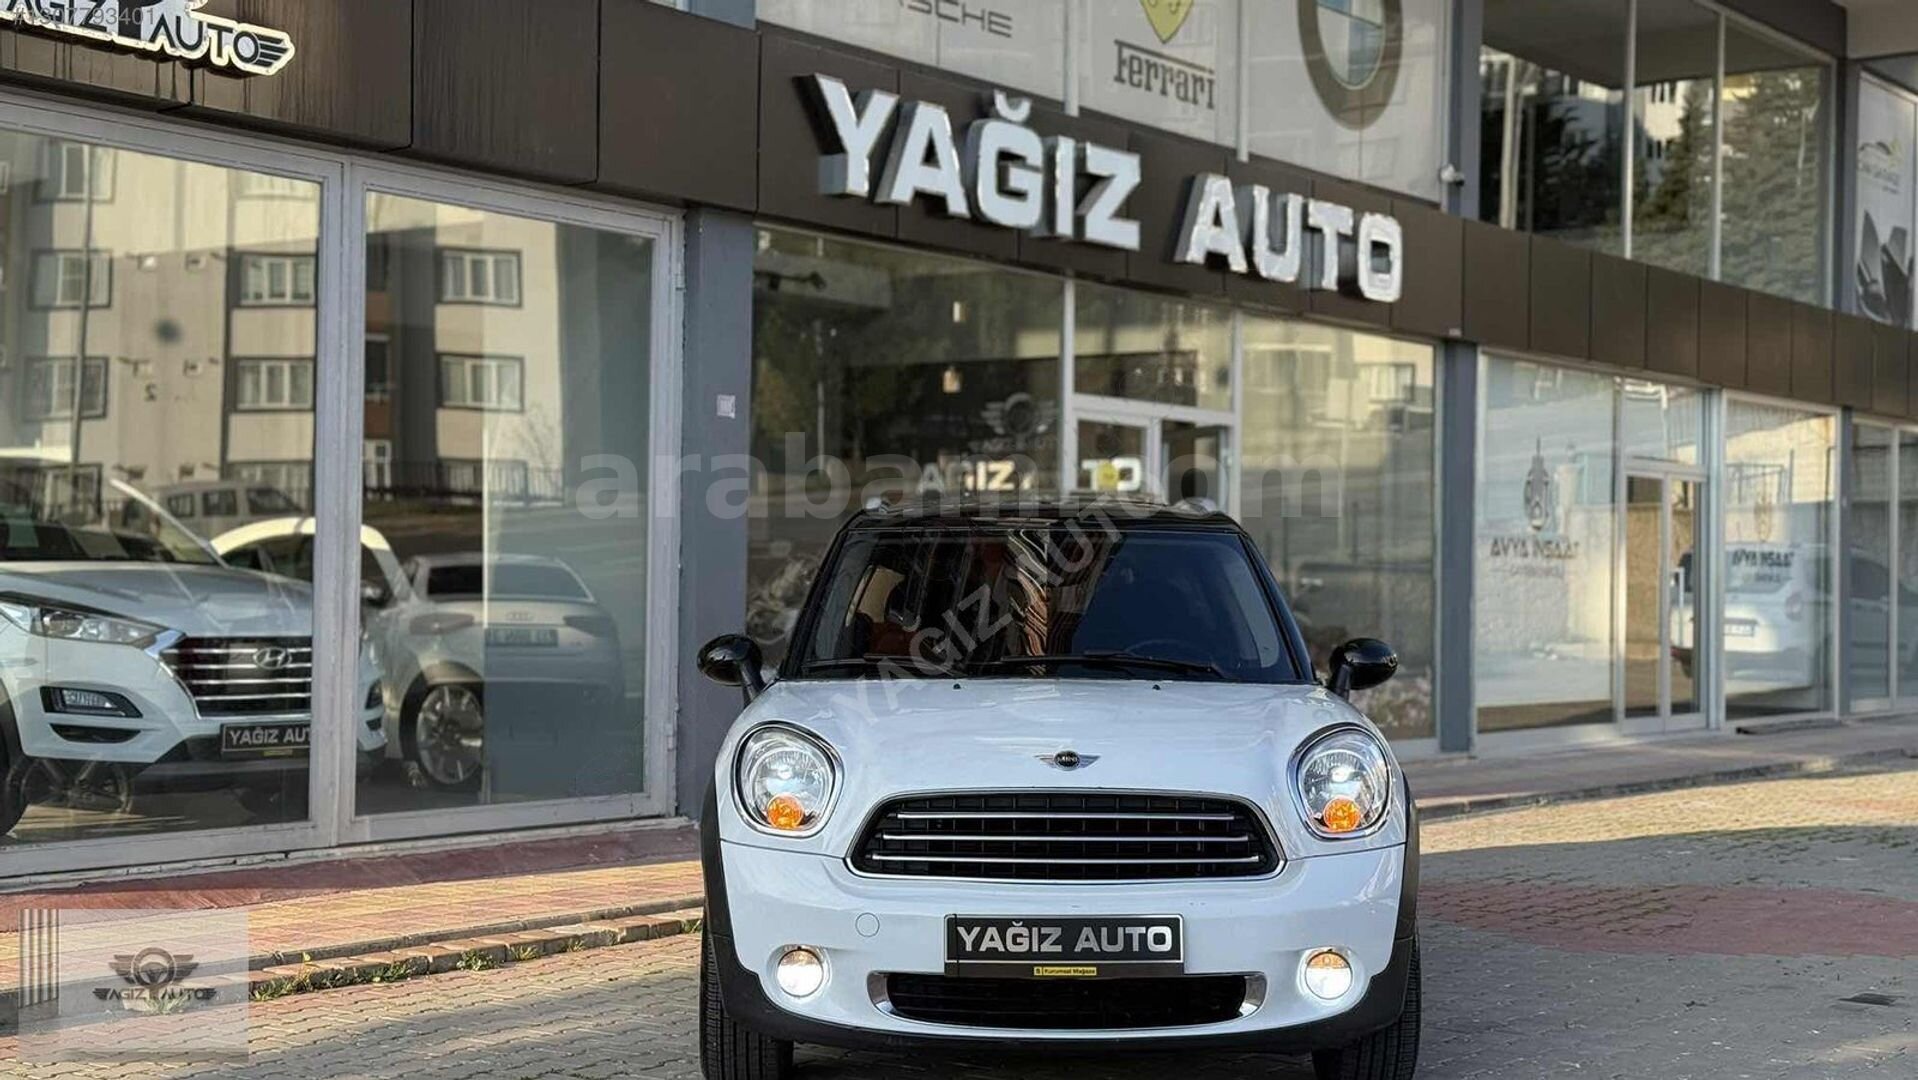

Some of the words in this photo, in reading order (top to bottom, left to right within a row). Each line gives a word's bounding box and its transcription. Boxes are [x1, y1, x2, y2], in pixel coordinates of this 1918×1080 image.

[149, 14, 260, 64] AUTO
[1114, 39, 1215, 110] Ferrari
[810, 72, 1141, 251] YAĞIZ
[1178, 173, 1403, 302] AUTO
[283, 727, 310, 744] AU
[957, 920, 1063, 953] YAĞIZ
[1073, 925, 1173, 953] AUTO
